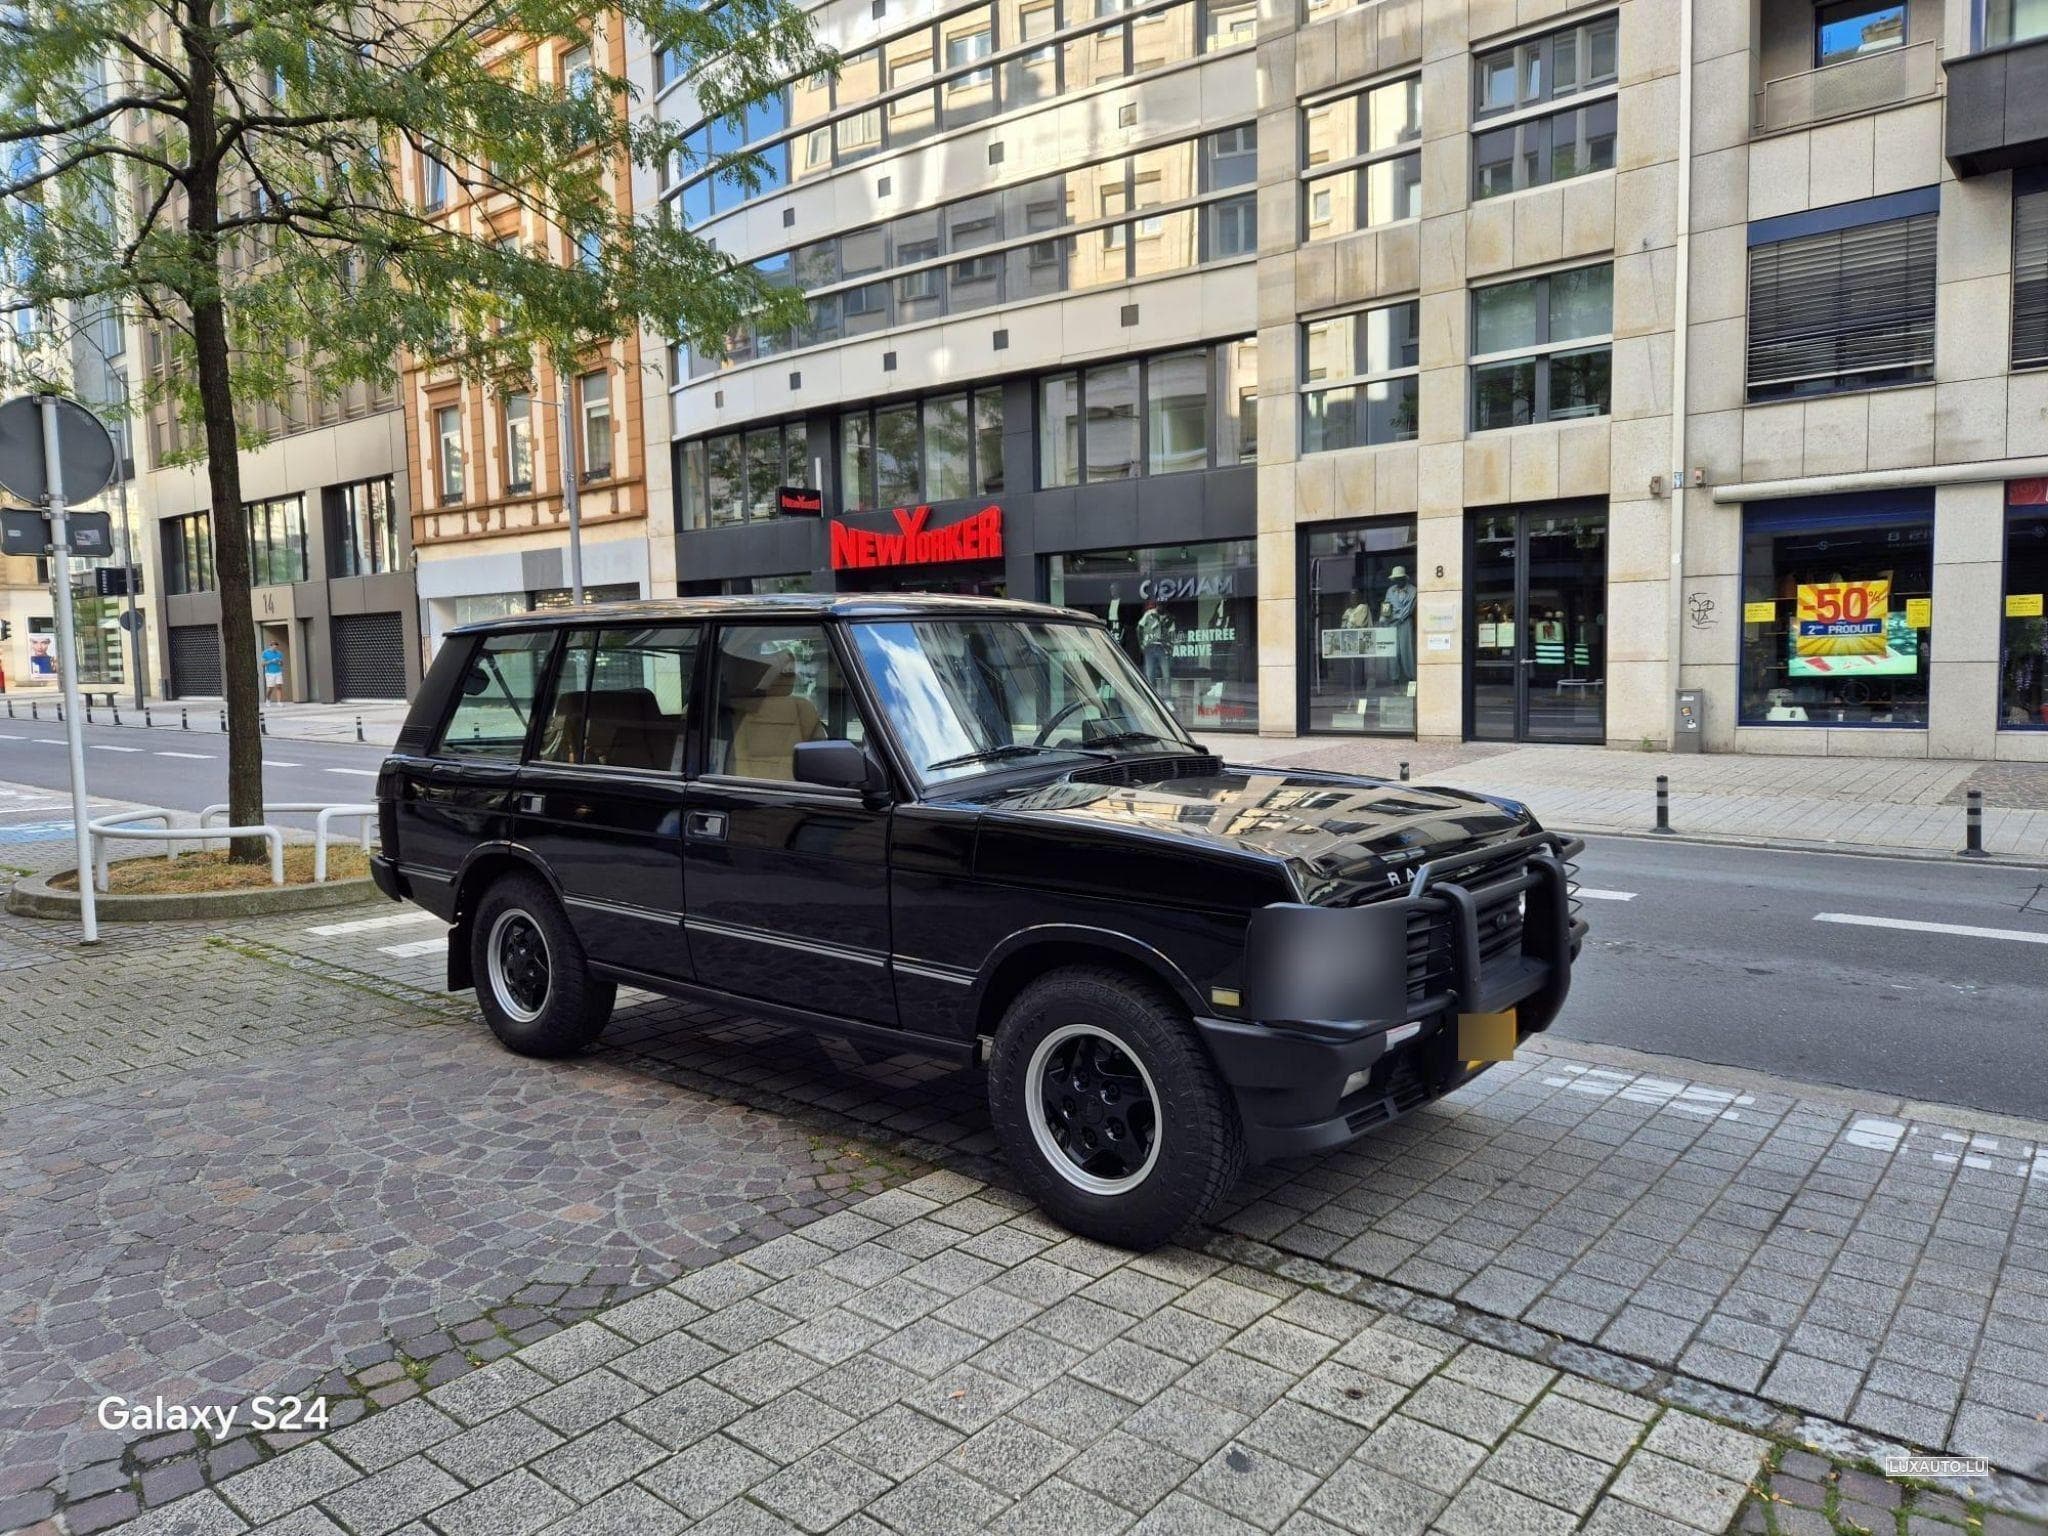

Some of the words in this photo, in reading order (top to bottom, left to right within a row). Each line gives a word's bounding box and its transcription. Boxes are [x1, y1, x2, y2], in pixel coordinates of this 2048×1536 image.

[1436, 565, 1444, 578] 8
[263, 593, 274, 613] 14
[1828, 623, 1874, 634] PRODUIT
